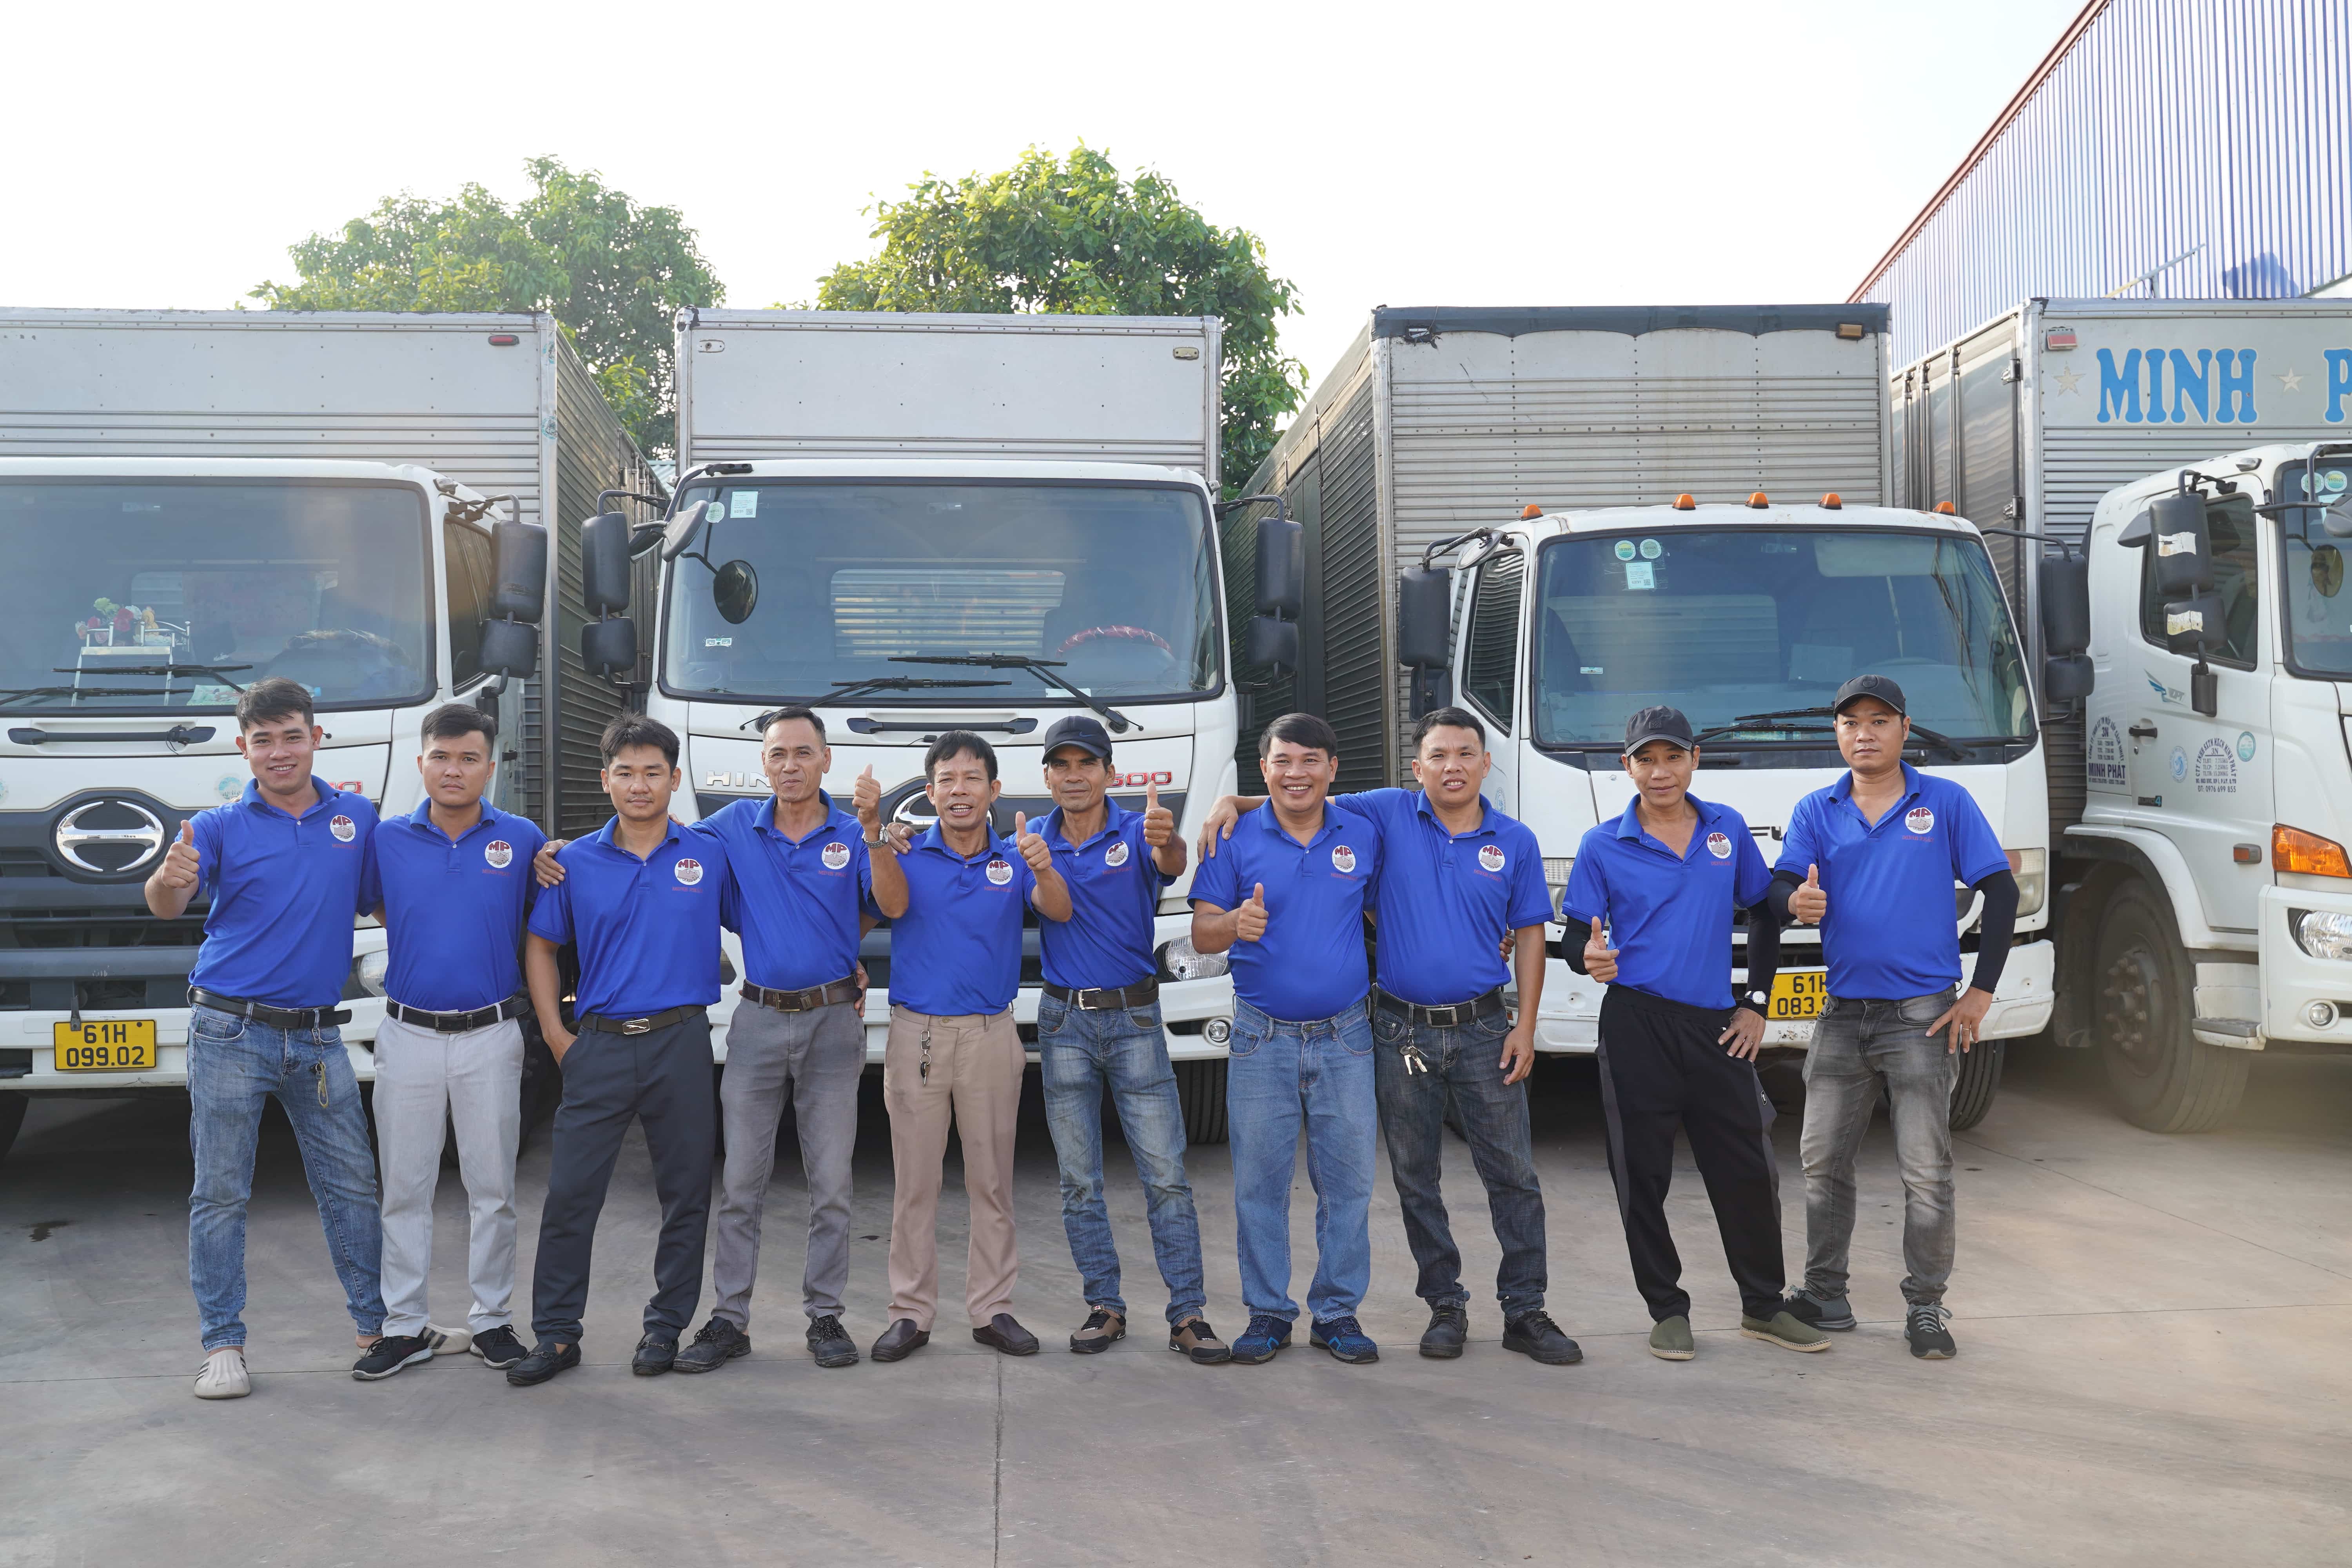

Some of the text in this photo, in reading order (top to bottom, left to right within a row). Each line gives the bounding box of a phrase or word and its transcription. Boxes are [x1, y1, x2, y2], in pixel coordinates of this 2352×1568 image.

[2096, 348, 2258, 424] MINH
[2089, 762, 2125, 779] MINH PHÁT
[1909, 808, 1931, 817] MP
[332, 816, 352, 825] MP
[1709, 833, 1726, 842] MP
[488, 841, 510, 851] MP
[825, 843, 847, 853] MP
[1335, 846, 1352, 856] MP
[1483, 846, 1503, 856] MP
[678, 859, 699, 868] MP
[84, 1024, 126, 1044] 61H
[66, 1046, 144, 1067] 099.02
